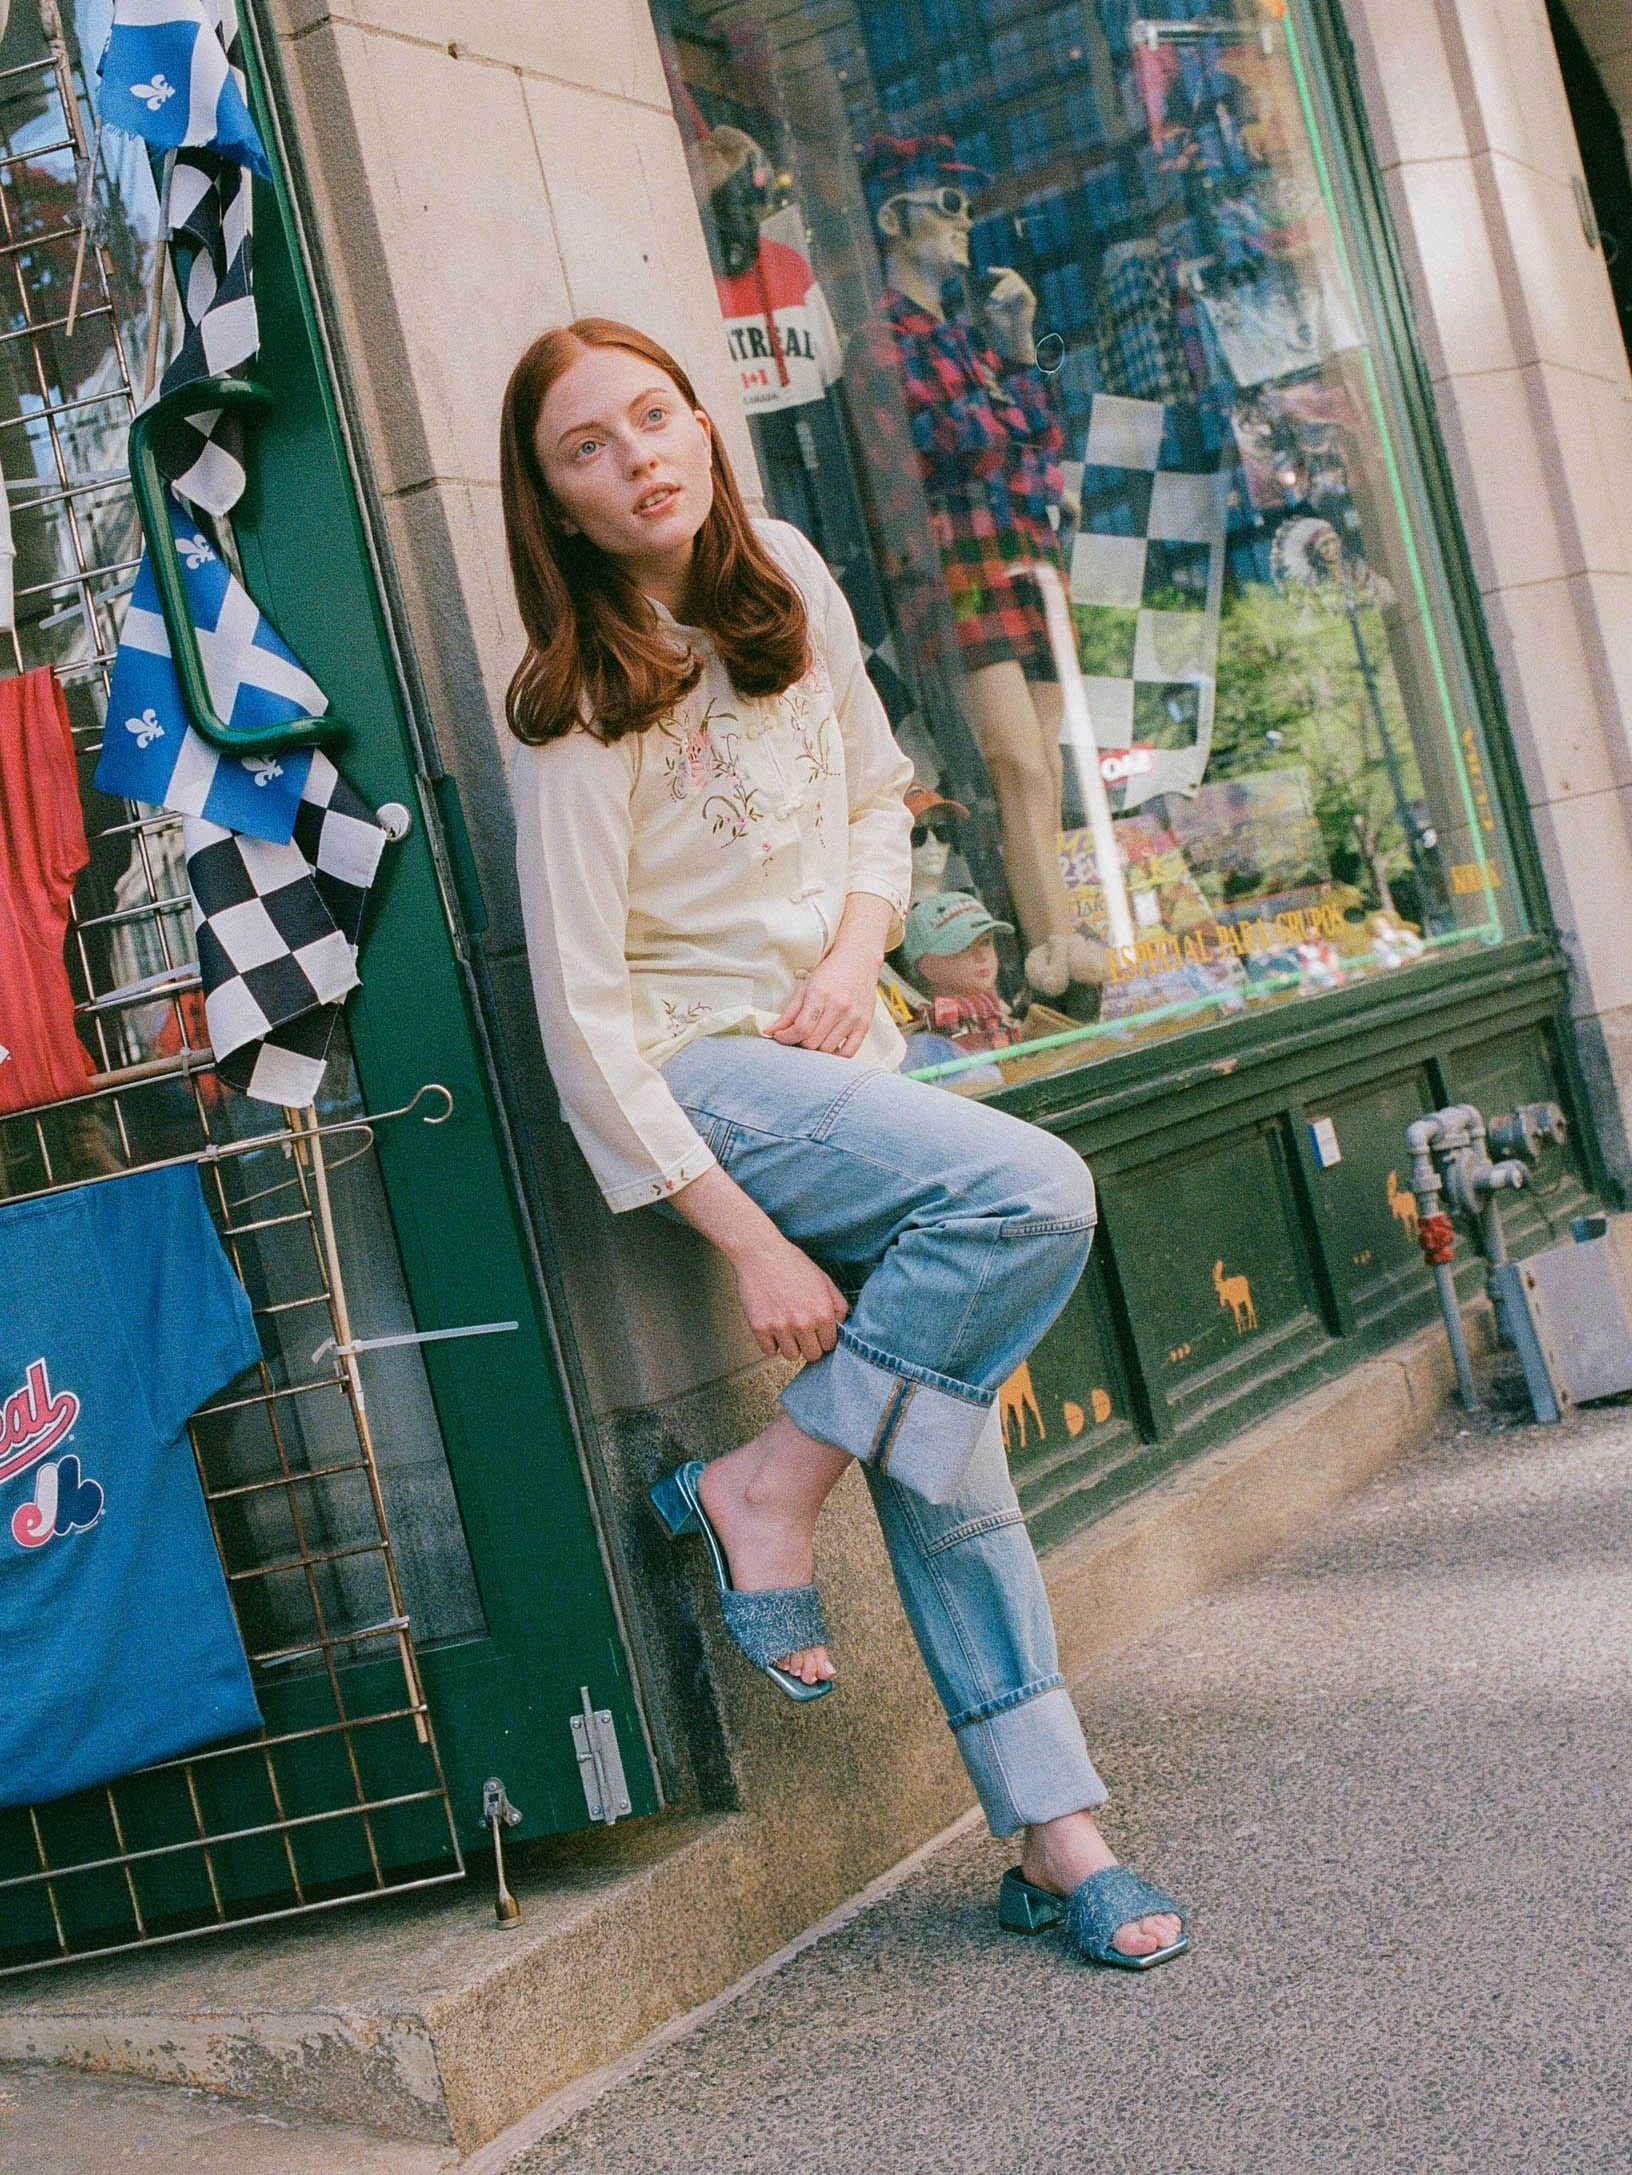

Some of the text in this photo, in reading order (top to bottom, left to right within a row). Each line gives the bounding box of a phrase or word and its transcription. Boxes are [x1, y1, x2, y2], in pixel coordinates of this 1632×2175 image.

[727, 327, 815, 361] TRAL
[1106, 929, 1214, 983] ESPECIAL
[1216, 918, 1272, 959] PARA
[0, 1357, 80, 1484] al
